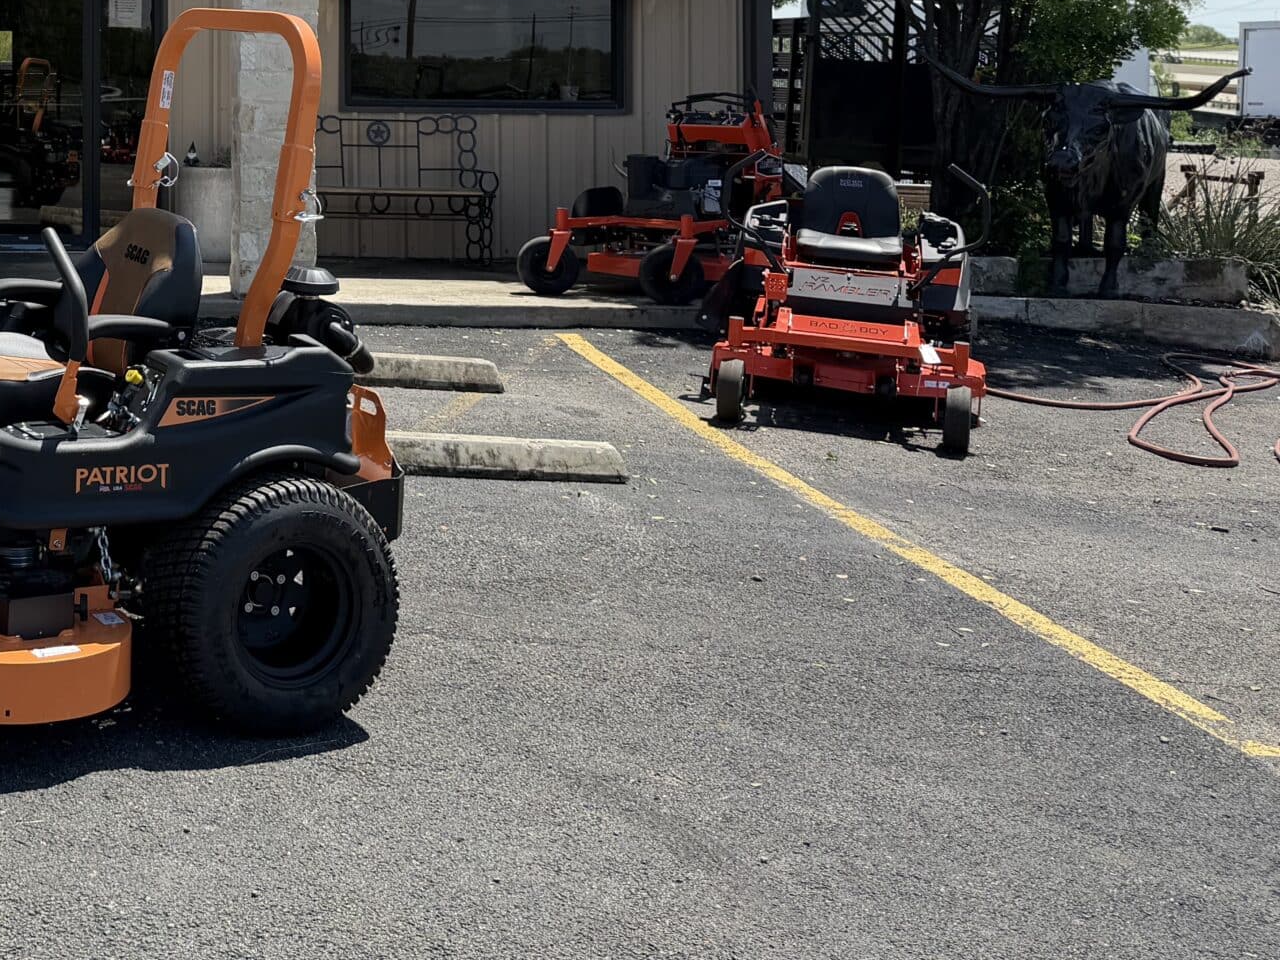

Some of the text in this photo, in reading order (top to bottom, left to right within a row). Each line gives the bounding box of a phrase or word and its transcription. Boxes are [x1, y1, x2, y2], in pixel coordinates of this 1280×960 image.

[124, 243, 151, 265] SCAG
[801, 281, 892, 298] RAMBLER
[809, 320, 889, 336] BAD BOY
[175, 399, 217, 417] SCAG
[75, 463, 170, 495] PATRIOT
